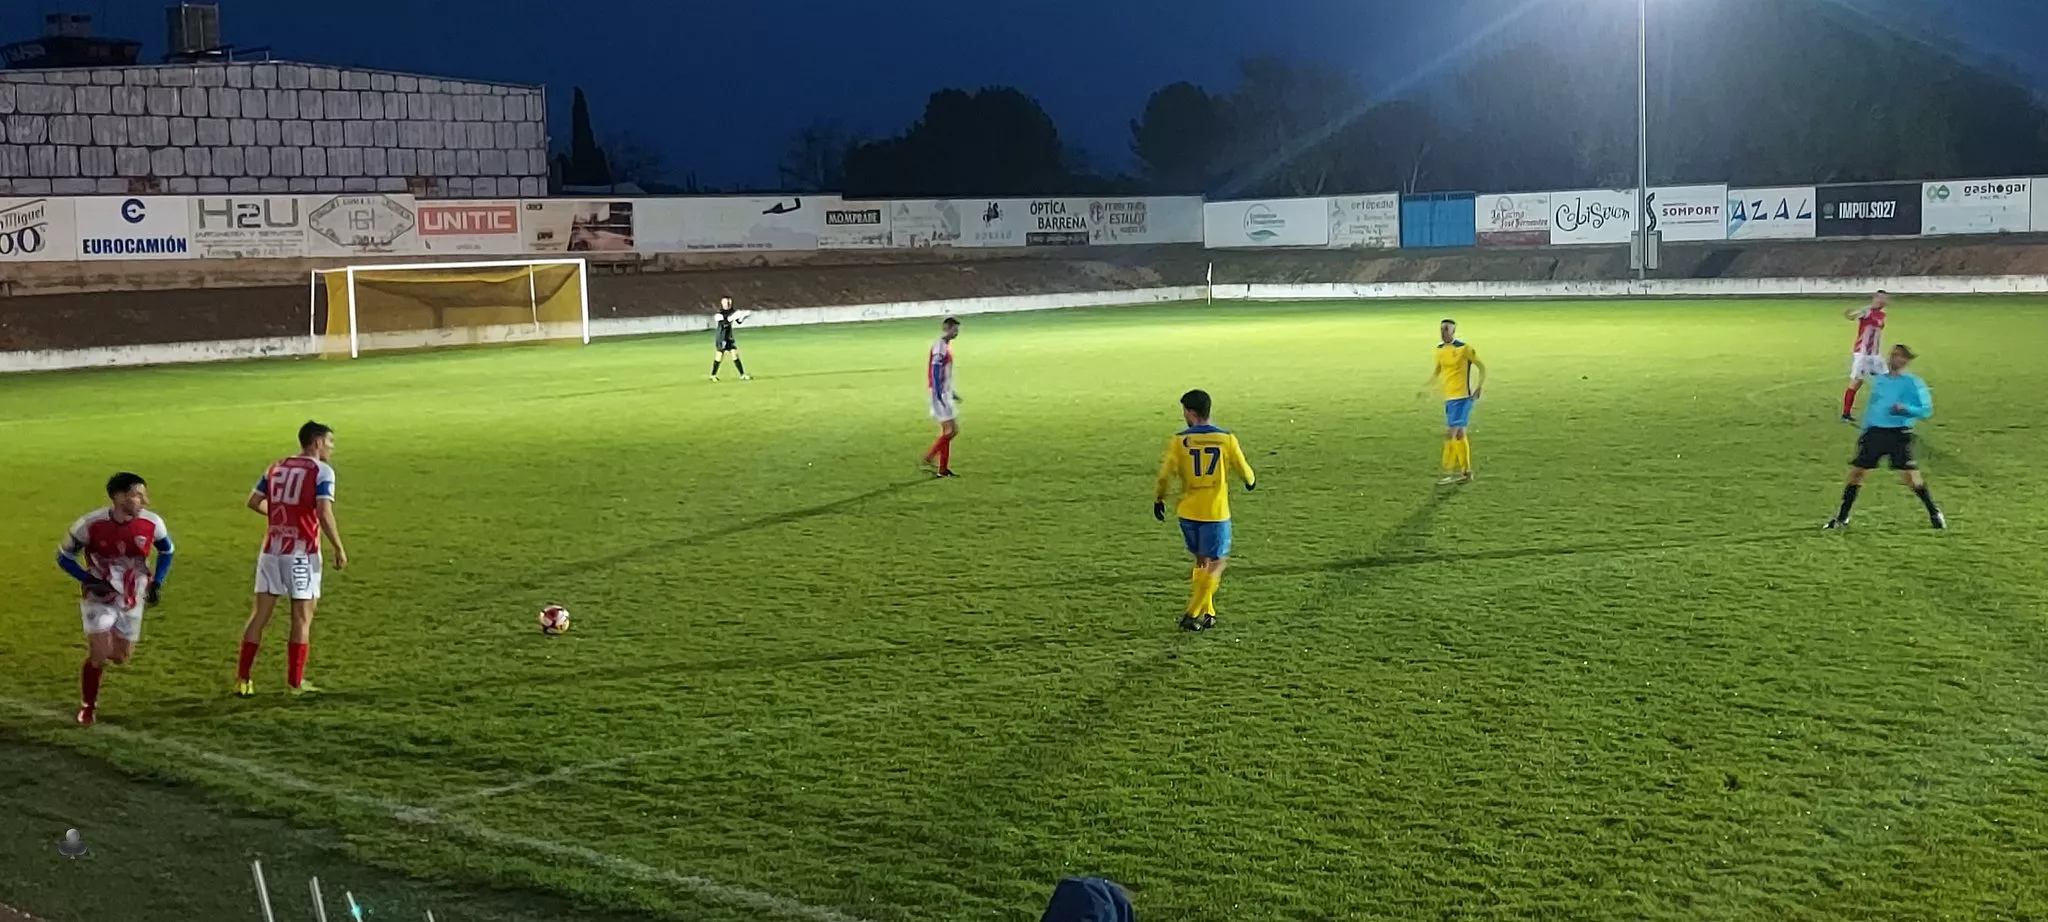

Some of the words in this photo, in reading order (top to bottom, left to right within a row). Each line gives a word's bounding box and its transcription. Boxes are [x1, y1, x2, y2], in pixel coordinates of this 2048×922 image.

[1964, 183, 2026, 196] gashogar
[1662, 205, 1720, 217] SOMPORT
[1731, 197, 1813, 221] AZAL
[1839, 201, 1896, 219] IMPULSO27
[423, 210, 512, 230] UNITIC
[82, 235, 187, 254] EUROCAMIÓN
[1189, 447, 1221, 477] 17
[270, 465, 307, 505] 20
